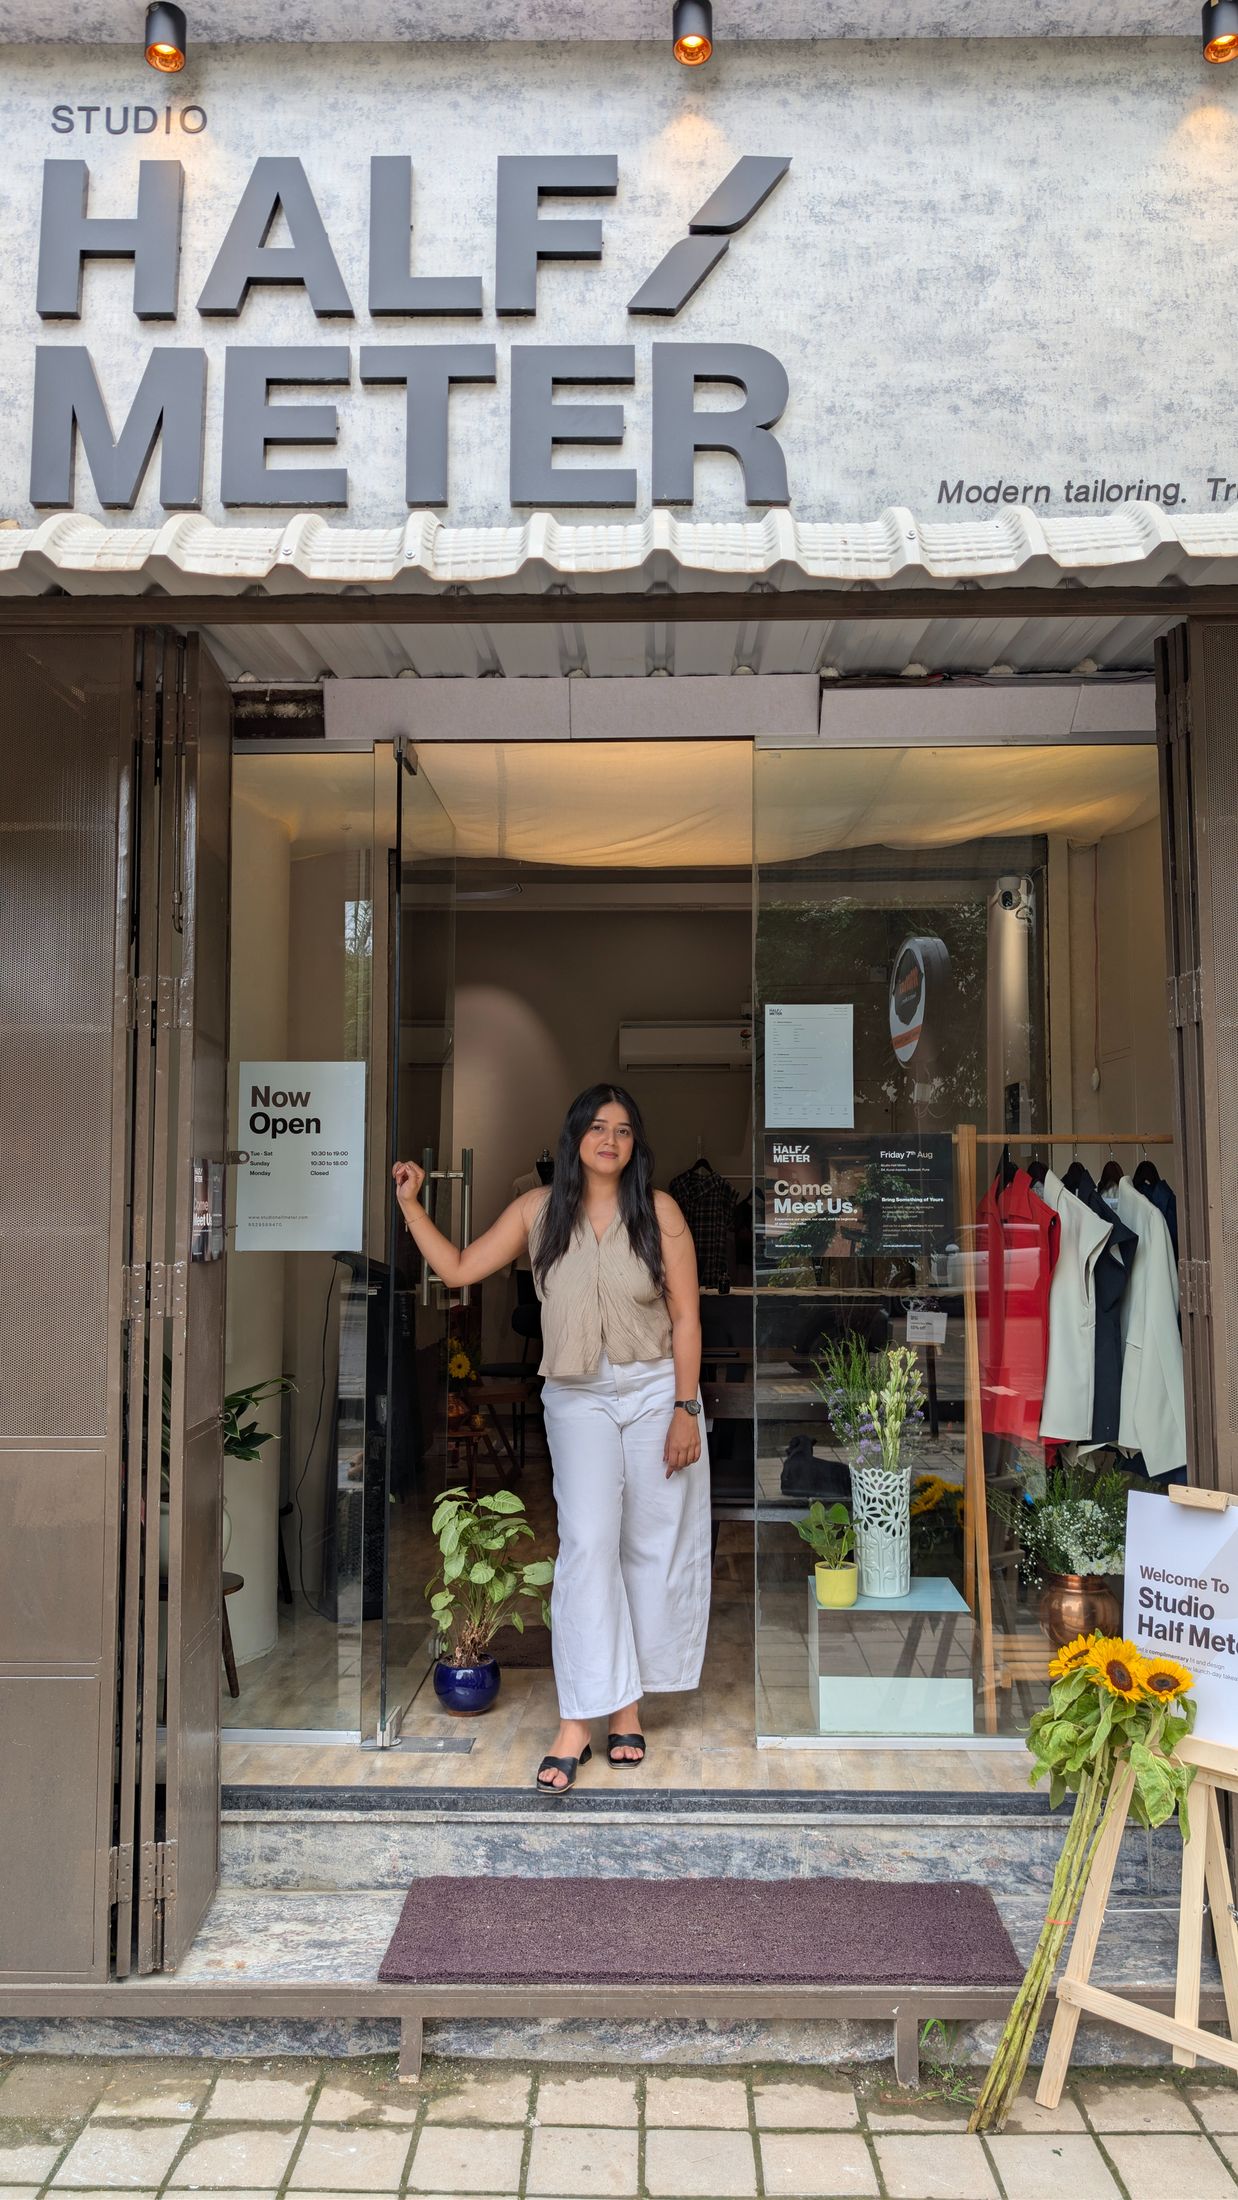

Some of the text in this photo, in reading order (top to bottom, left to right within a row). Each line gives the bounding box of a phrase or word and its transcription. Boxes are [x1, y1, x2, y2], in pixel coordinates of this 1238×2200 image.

[51, 103, 208, 135] STUDIO
[29, 342, 792, 511] METER
[937, 477, 1238, 506] Modern tailoring. Tr
[251, 1086, 311, 1107] Now
[249, 1112, 321, 1139] Open
[773, 1154, 811, 1163] METER
[880, 1150, 905, 1160] Friday
[917, 1151, 933, 1160] Aug
[774, 1179, 833, 1196] Come
[774, 1198, 858, 1214] Meet Us.
[1140, 1565, 1229, 1594] Welcome To
[1138, 1586, 1215, 1620] Studio
[1137, 1613, 1238, 1655] Half Met
[1149, 1649, 1189, 1663] complimentary
